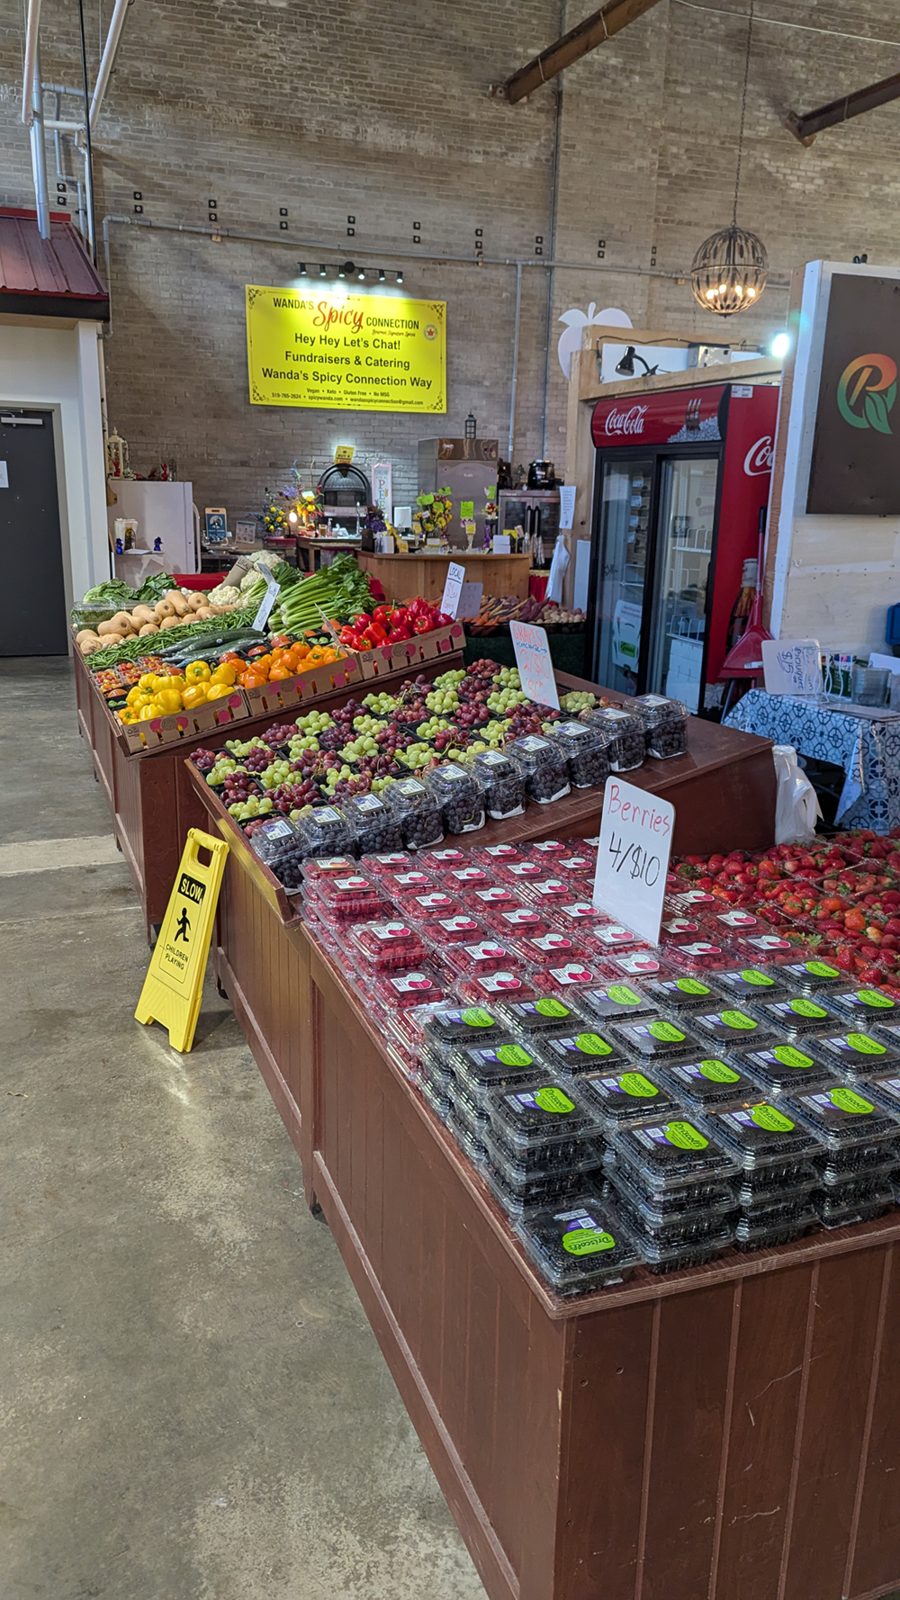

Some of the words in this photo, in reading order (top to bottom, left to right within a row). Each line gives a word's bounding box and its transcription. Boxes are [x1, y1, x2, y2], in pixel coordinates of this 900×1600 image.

[273, 298, 314, 310] WANDA'S
[312, 301, 364, 334] Spicy
[366, 316, 420, 330] CONNECTION
[294, 333, 316, 346] Hey
[319, 335, 340, 348] Hey
[344, 336, 369, 348] Let's
[372, 340, 401, 350] Chat!
[285, 351, 350, 364] Fundraisers
[354, 356, 362, 366] &
[366, 357, 410, 370] Catering
[262, 368, 309, 381] Wanda's
[312, 370, 342, 384] Spicy
[346, 374, 407, 386] Connection
[410, 378, 432, 390] Way
[608, 784, 670, 836] Berries
[608, 831, 660, 886] 4/$10
[180, 877, 204, 902] SLOW
[165, 955, 185, 970] PLAYING
[166, 943, 189, 962] CHILDREN
